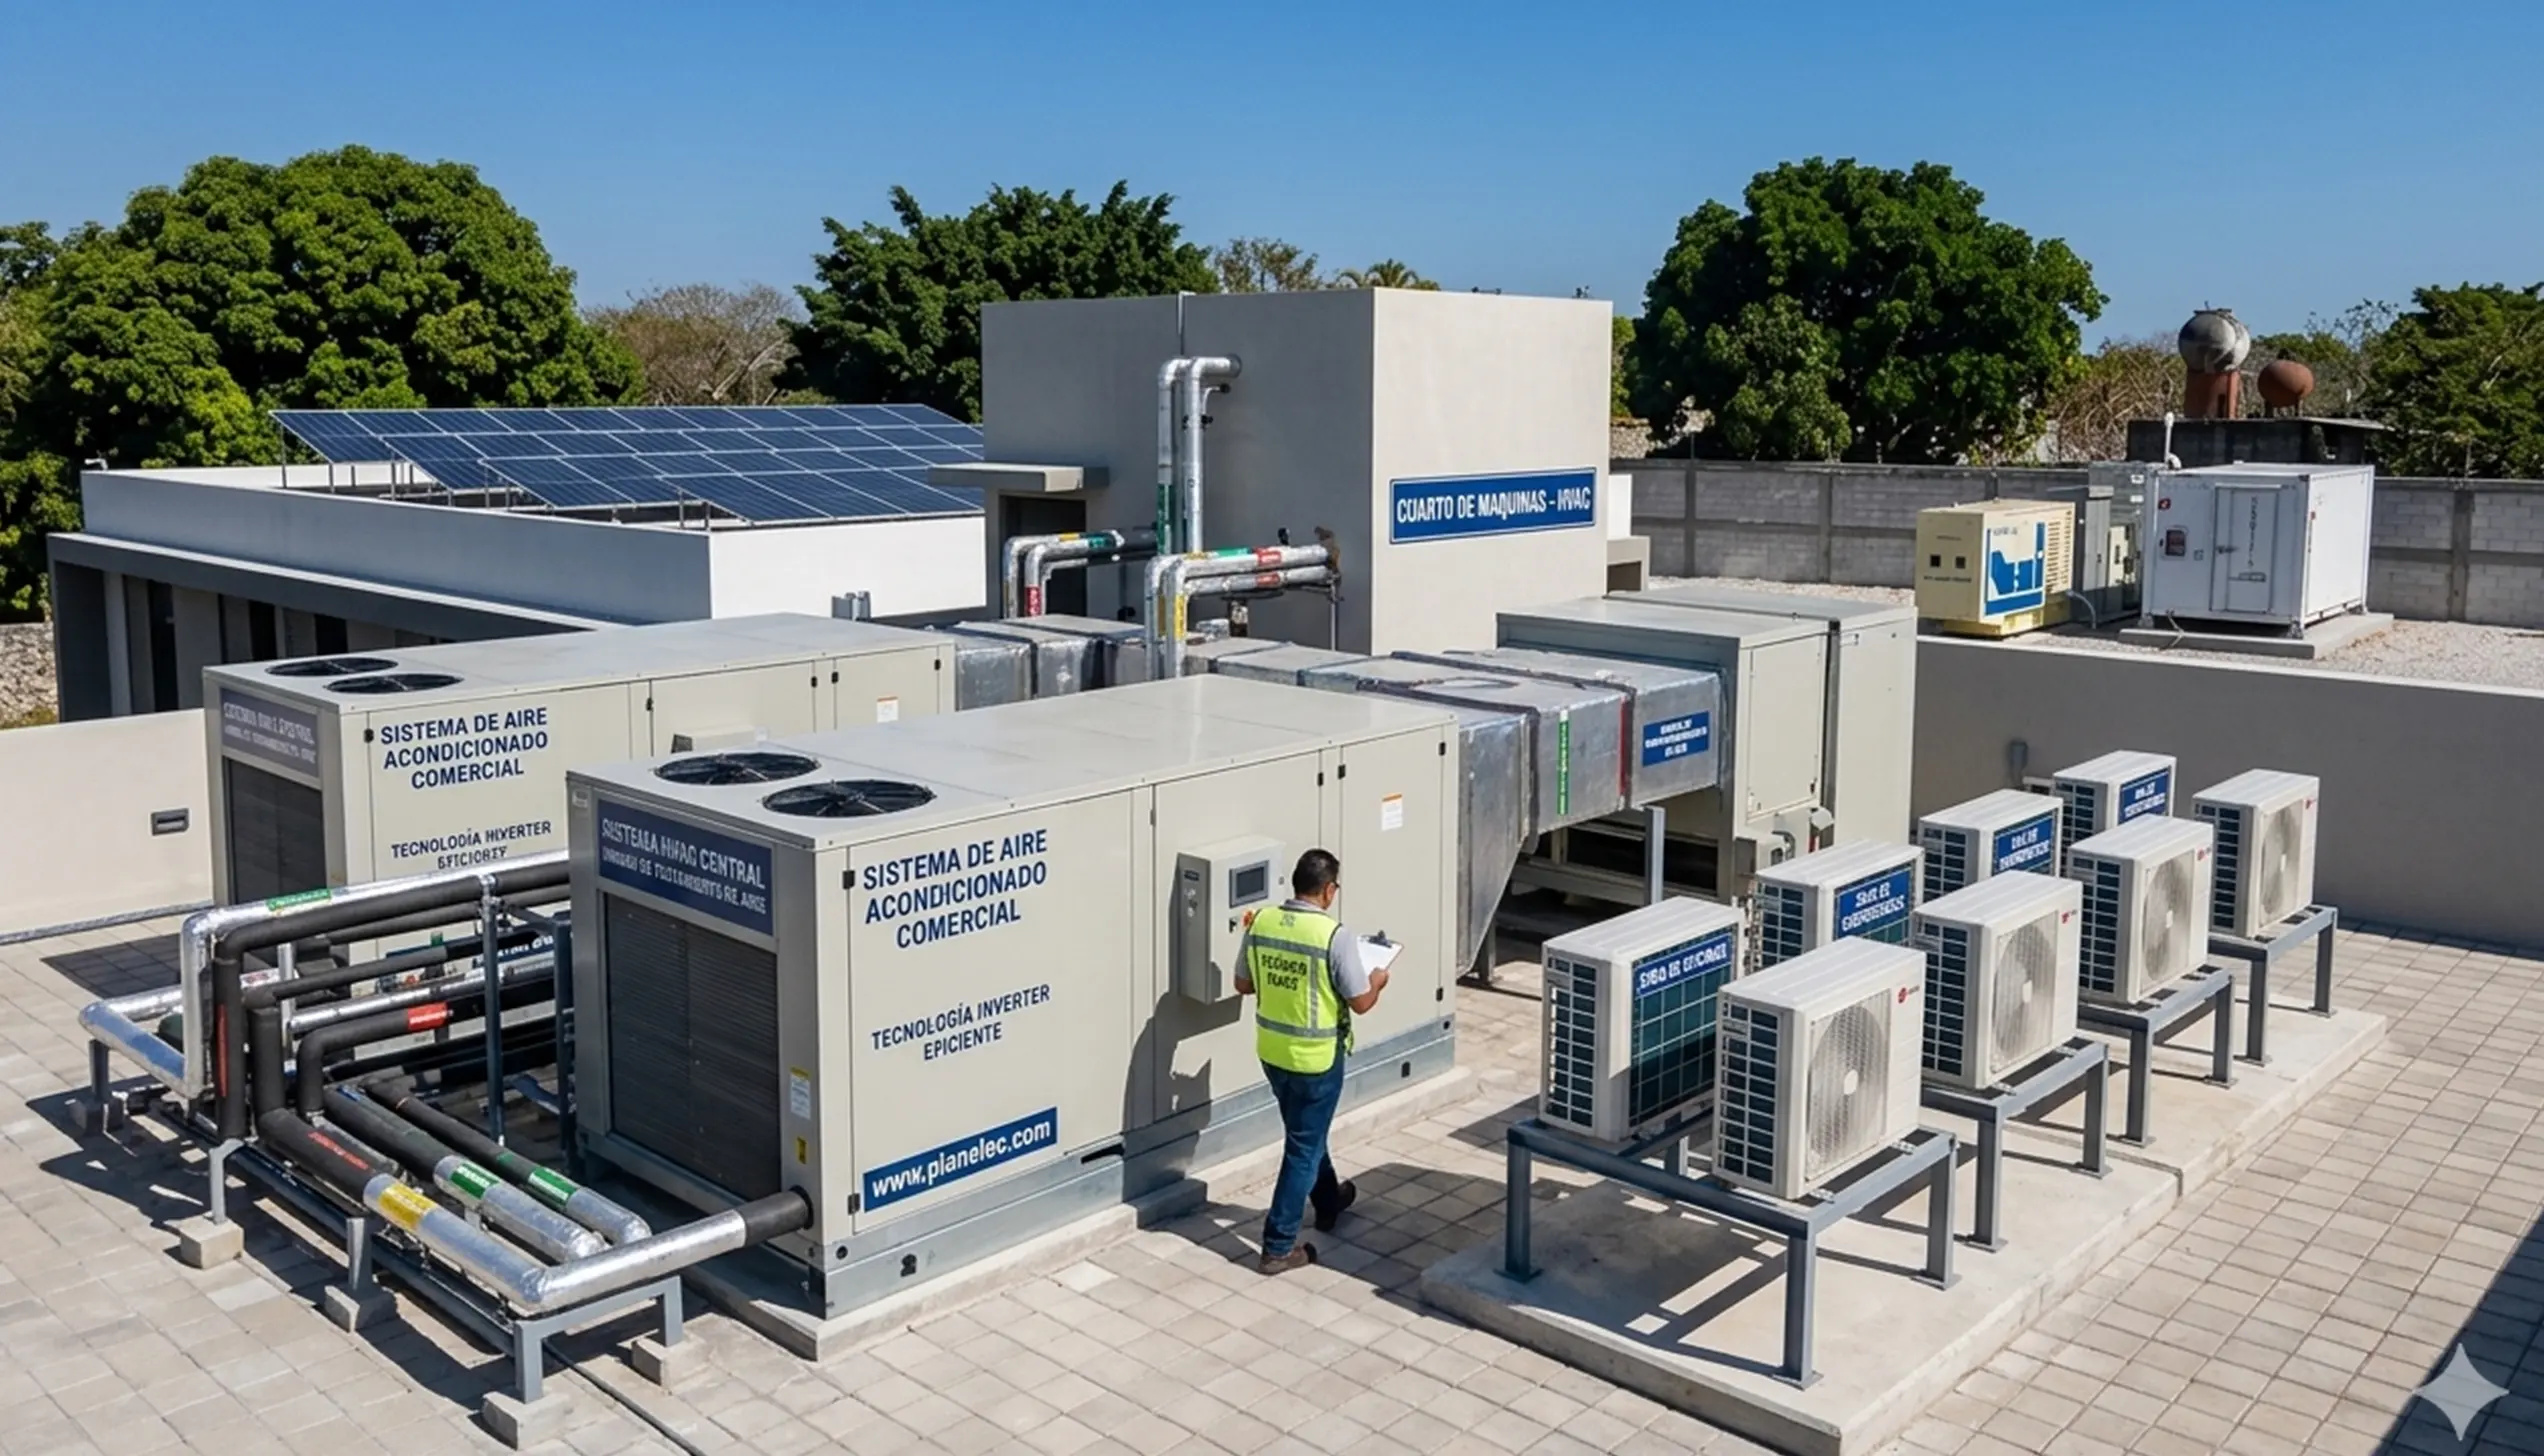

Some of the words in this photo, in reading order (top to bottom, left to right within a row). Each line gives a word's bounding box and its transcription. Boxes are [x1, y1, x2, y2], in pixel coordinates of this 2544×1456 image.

[1397, 496, 1453, 523] CUARTO
[381, 717, 468, 745] SISTEMA
[474, 713, 499, 734] DE
[504, 707, 548, 729] AIRE
[384, 731, 548, 769] ACONDICIONADO
[411, 758, 524, 789] COMERCIAL
[700, 849, 766, 890] CENTRAL
[863, 848, 960, 890] SISTEMA
[967, 840, 994, 868] DE
[1000, 829, 1047, 861] AIRE
[865, 861, 1047, 924] ACONDICIONADO
[897, 898, 1021, 948] COMERCIAL
[872, 1003, 973, 1050] TECNOLOGÍA
[977, 984, 1050, 1020] INVERTER
